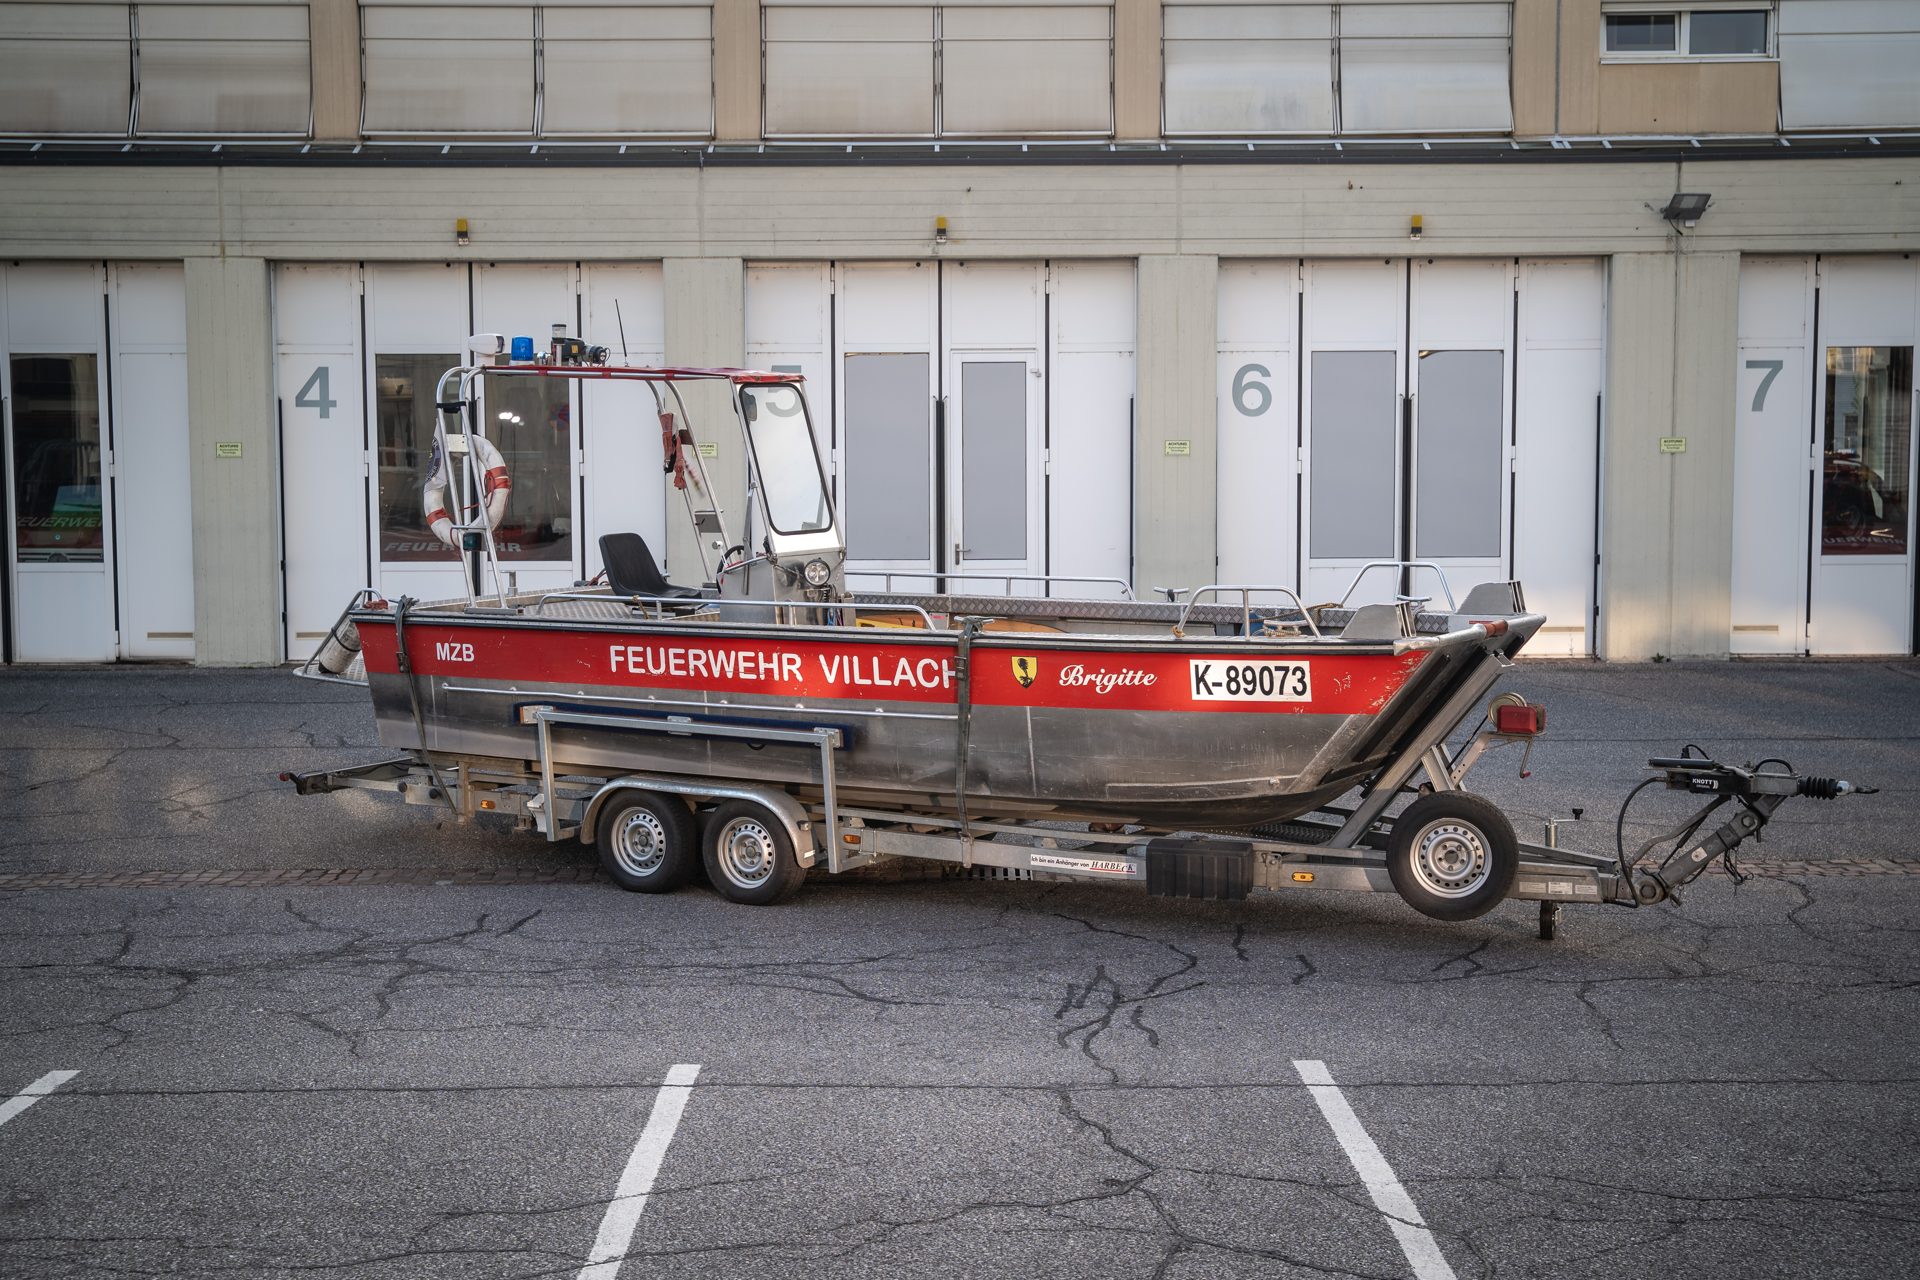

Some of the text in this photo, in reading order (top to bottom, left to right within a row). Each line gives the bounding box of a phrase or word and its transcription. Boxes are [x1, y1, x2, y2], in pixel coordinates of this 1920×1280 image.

[295, 367, 336, 418] 4
[765, 365, 802, 418] 5
[1231, 363, 1272, 417] 6
[1745, 359, 1784, 412] 7
[436, 642, 475, 662] MZB
[609, 645, 804, 683] FEUERWEHR
[1058, 664, 1158, 694] Brigitte
[1194, 664, 1307, 697] K-89073
[1056, 858, 1079, 867] Anhänger
[1091, 861, 1134, 872] HARBECK
